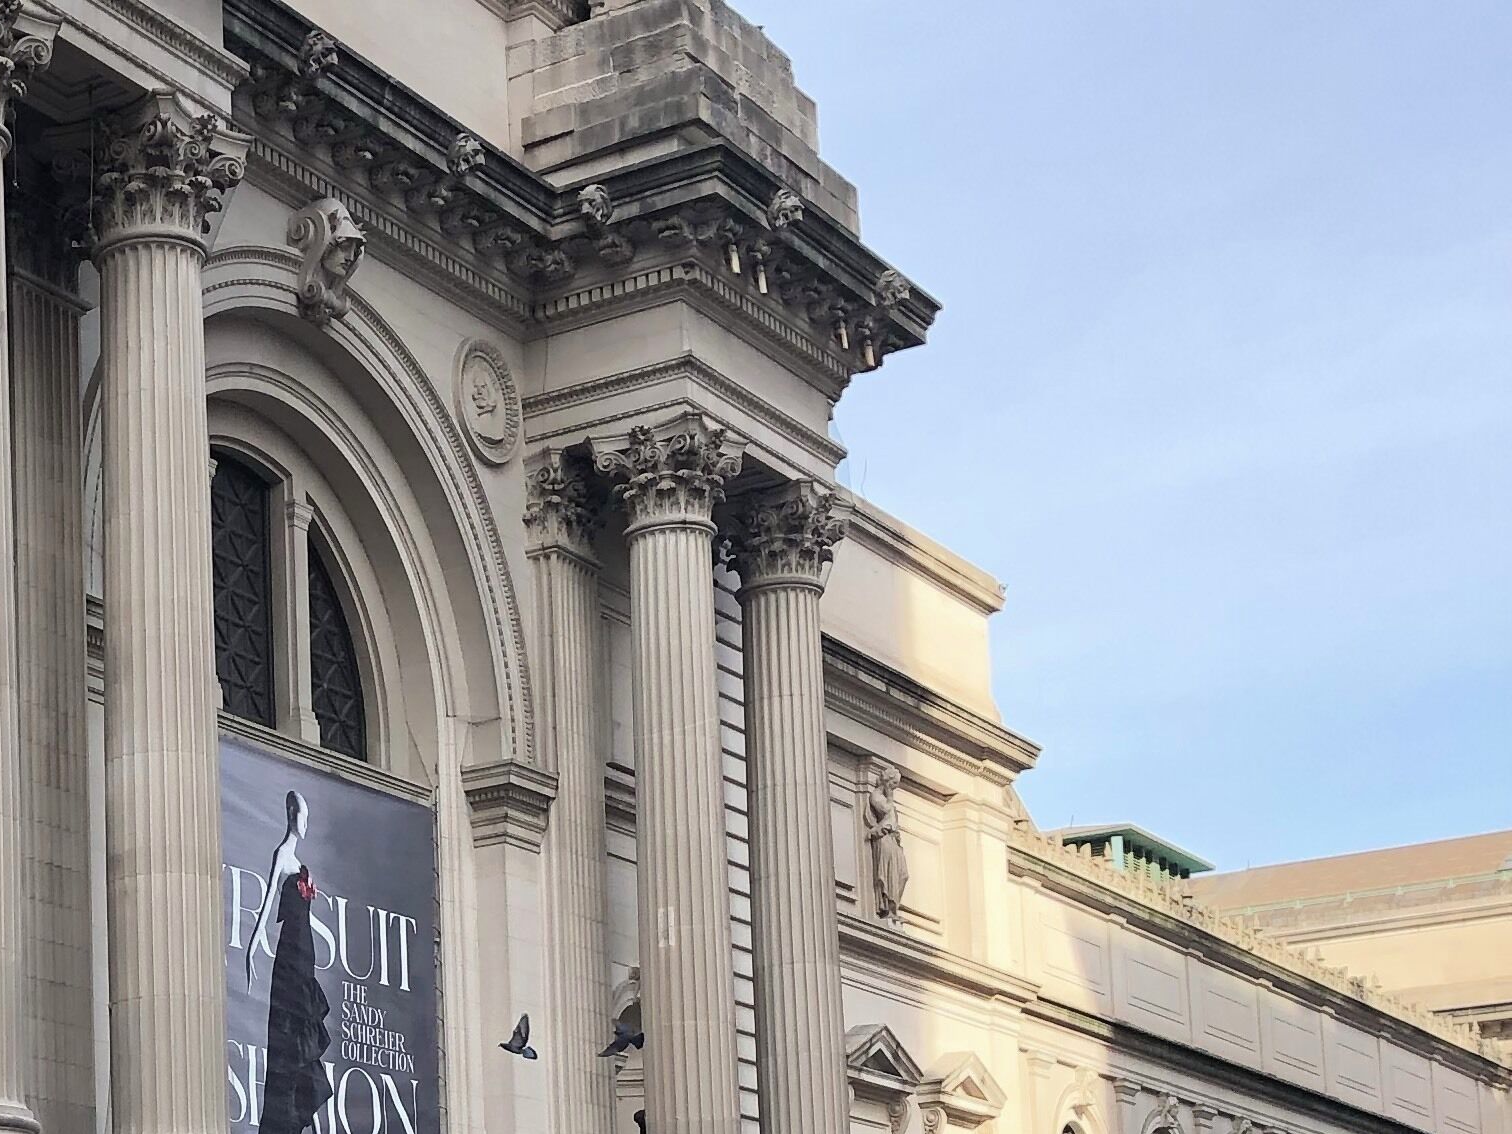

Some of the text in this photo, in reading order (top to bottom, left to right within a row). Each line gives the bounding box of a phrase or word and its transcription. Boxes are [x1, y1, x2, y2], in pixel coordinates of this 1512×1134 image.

[223, 863, 418, 992] RSUIT
[341, 981, 368, 1005] THE
[341, 1001, 387, 1029] SANDY
[341, 1021, 406, 1053] SCHREIER
[341, 1041, 415, 1074] COLLECTION
